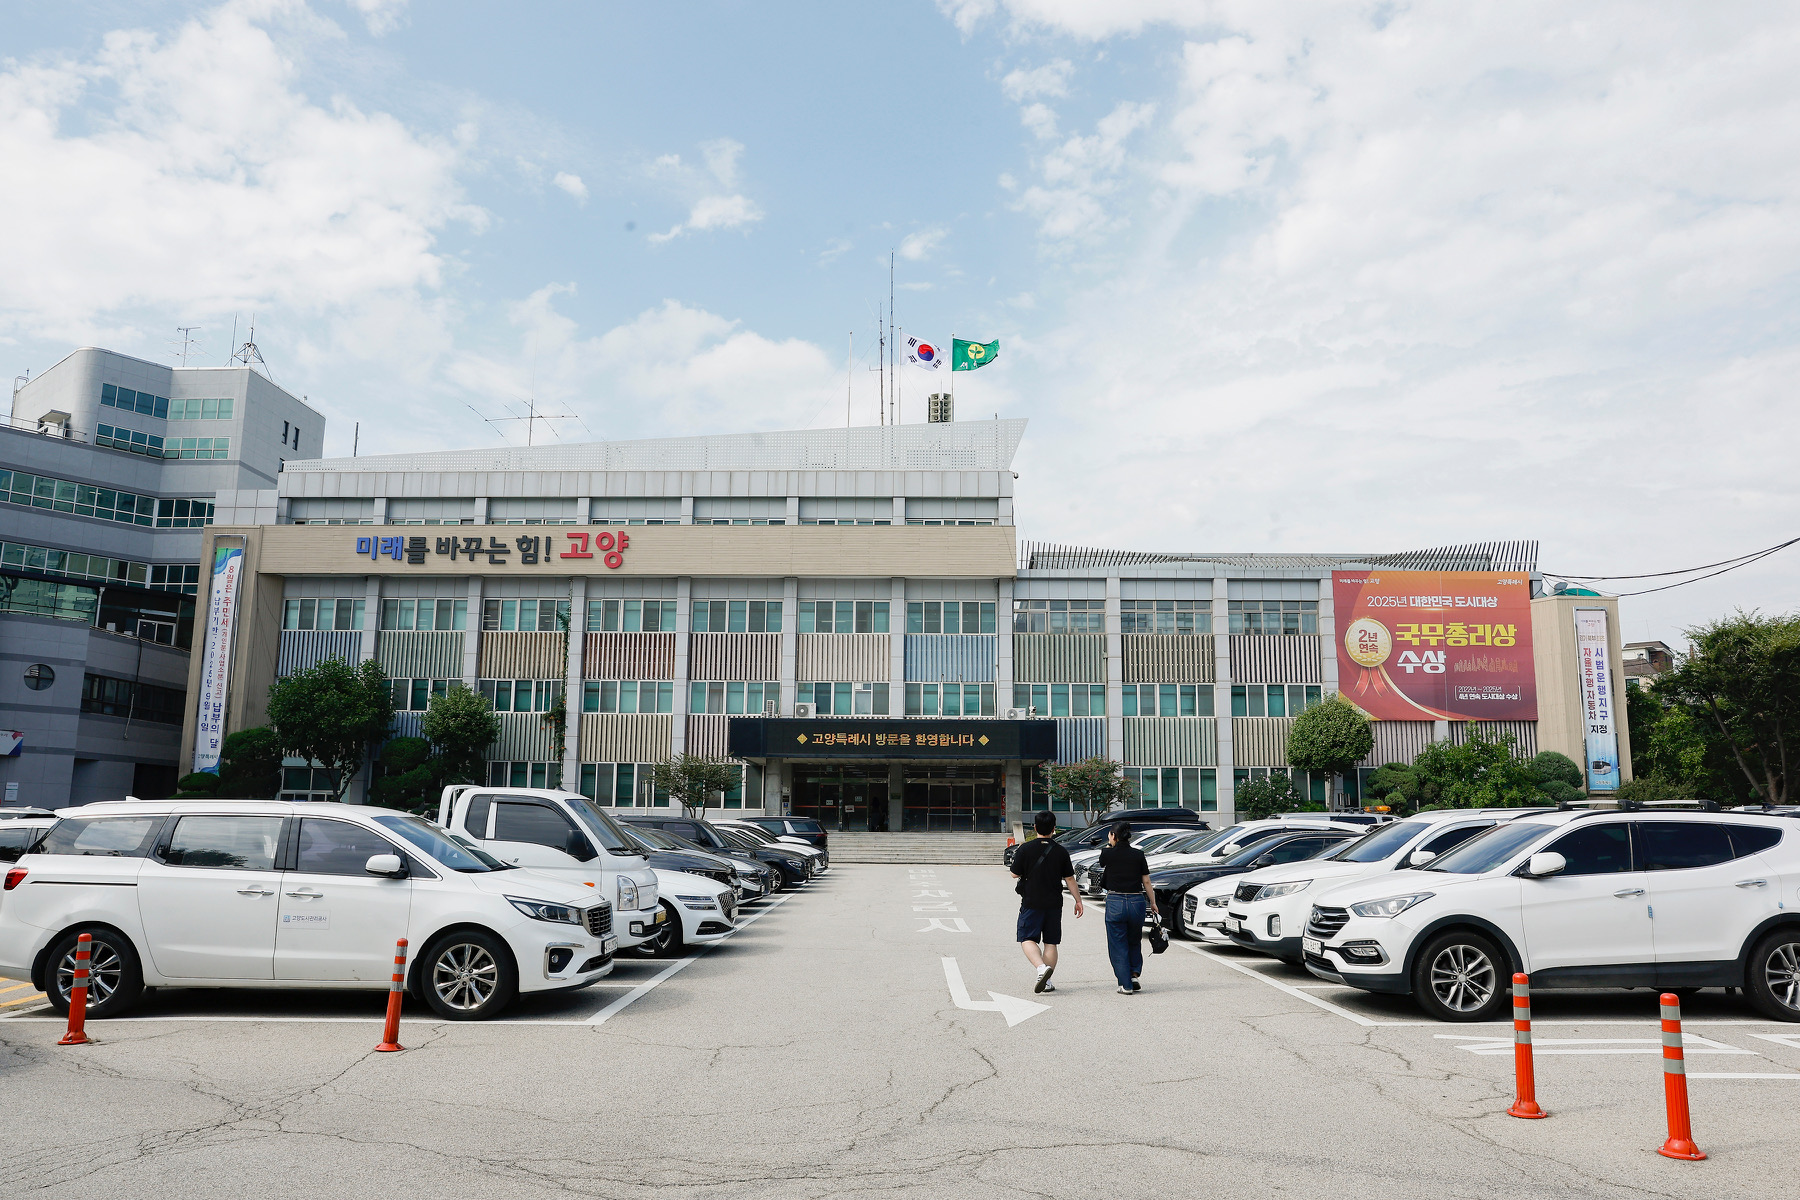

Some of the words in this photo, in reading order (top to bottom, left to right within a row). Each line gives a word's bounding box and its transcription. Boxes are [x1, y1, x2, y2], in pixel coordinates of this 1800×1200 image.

[356, 536, 430, 564] 미래를
[436, 536, 511, 564] 바꾸는
[516, 535, 551, 564] 힘!
[560, 531, 630, 568] 고양
[1366, 595, 1408, 607] 2025년
[1409, 595, 1453, 608] 대한민국
[1455, 596, 1498, 608] 도시대상
[1358, 629, 1378, 643] 2년
[1395, 622, 1518, 647] 국무총리상
[1359, 643, 1379, 654] 연속
[1397, 650, 1447, 674] 수상
[1583, 648, 1595, 688] 자율주행
[1595, 648, 1608, 720] 시범운행지구
[1587, 691, 1597, 720] 자동차
[210, 703, 222, 734] 납부의
[1591, 725, 1608, 734] 지정
[210, 738, 219, 749] 달
[812, 733, 871, 746] 고양특례시
[875, 733, 911, 746] 방문을
[915, 733, 975, 747] 환영합니다
